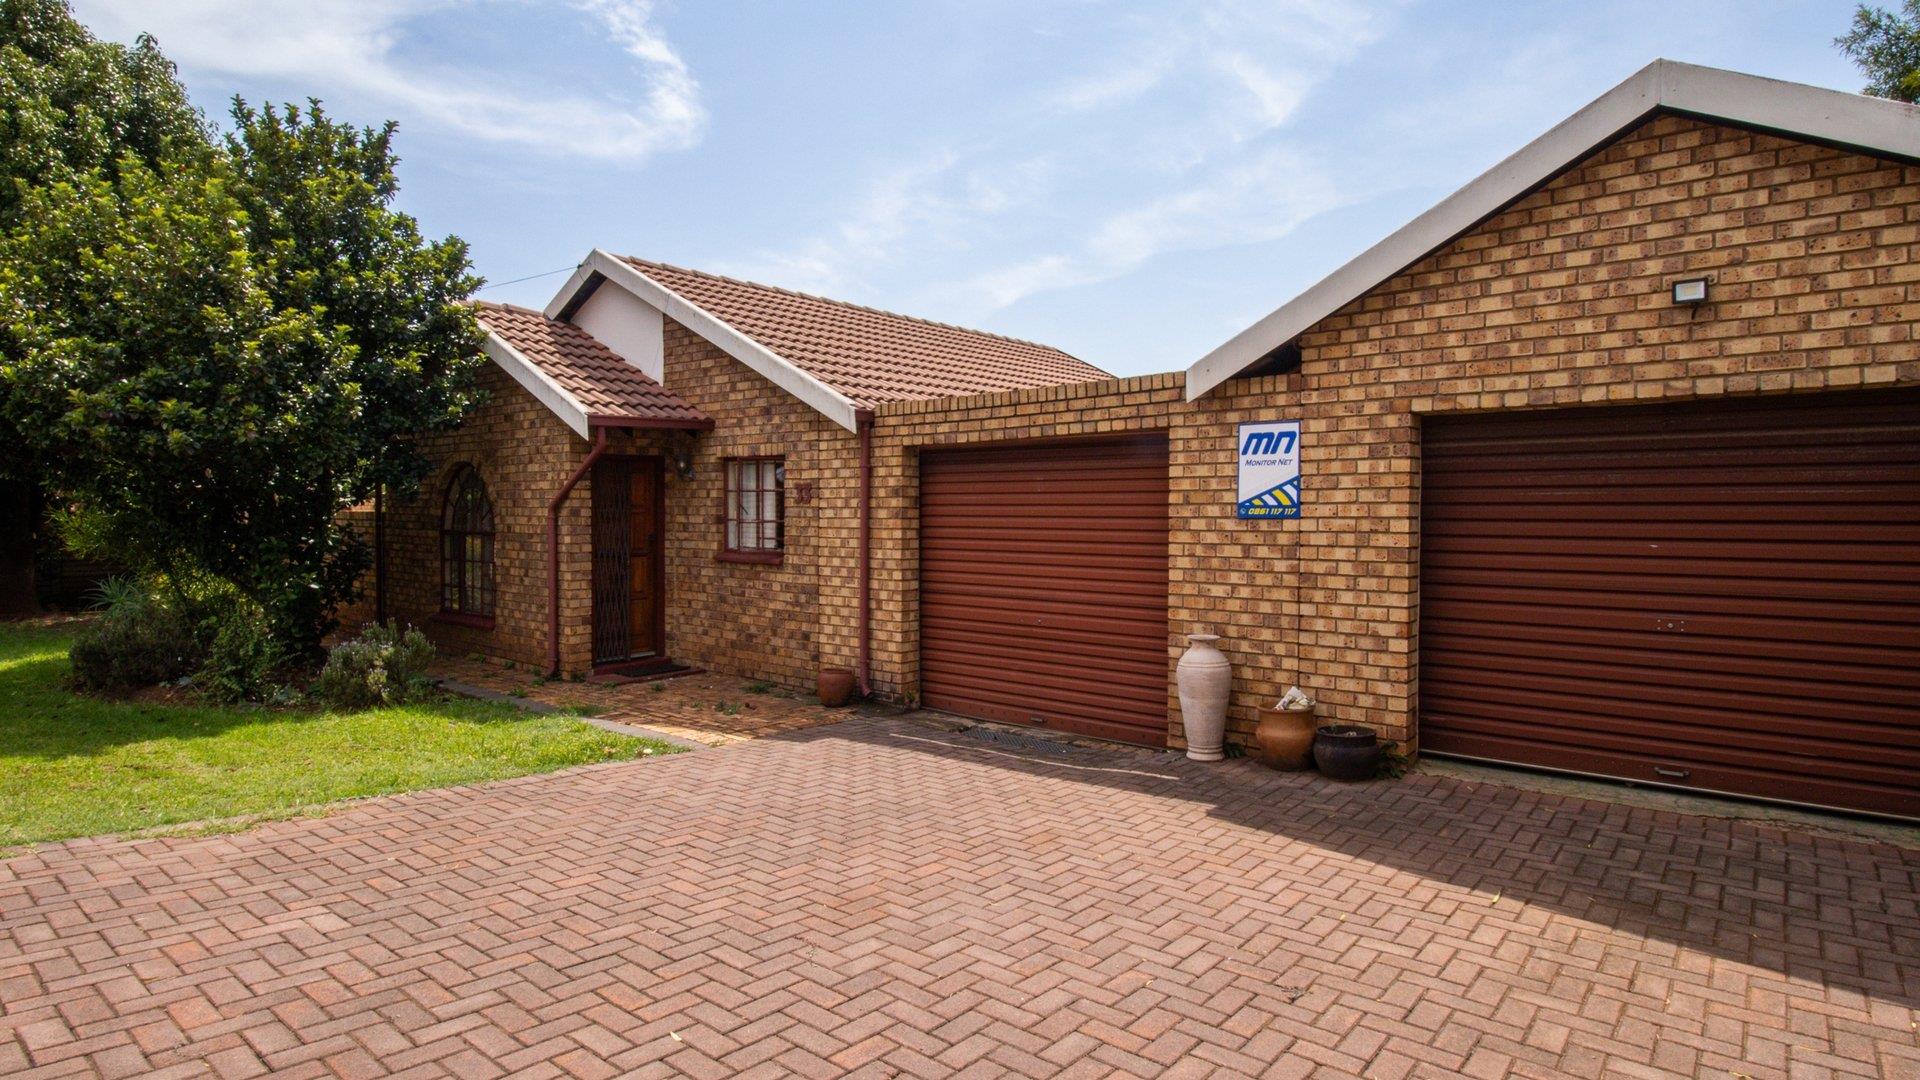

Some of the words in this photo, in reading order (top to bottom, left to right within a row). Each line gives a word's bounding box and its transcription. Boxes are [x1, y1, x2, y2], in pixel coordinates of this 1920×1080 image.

[1278, 458, 1293, 466] NET
[1270, 507, 1283, 515] 117
[1284, 507, 1296, 515] 117
